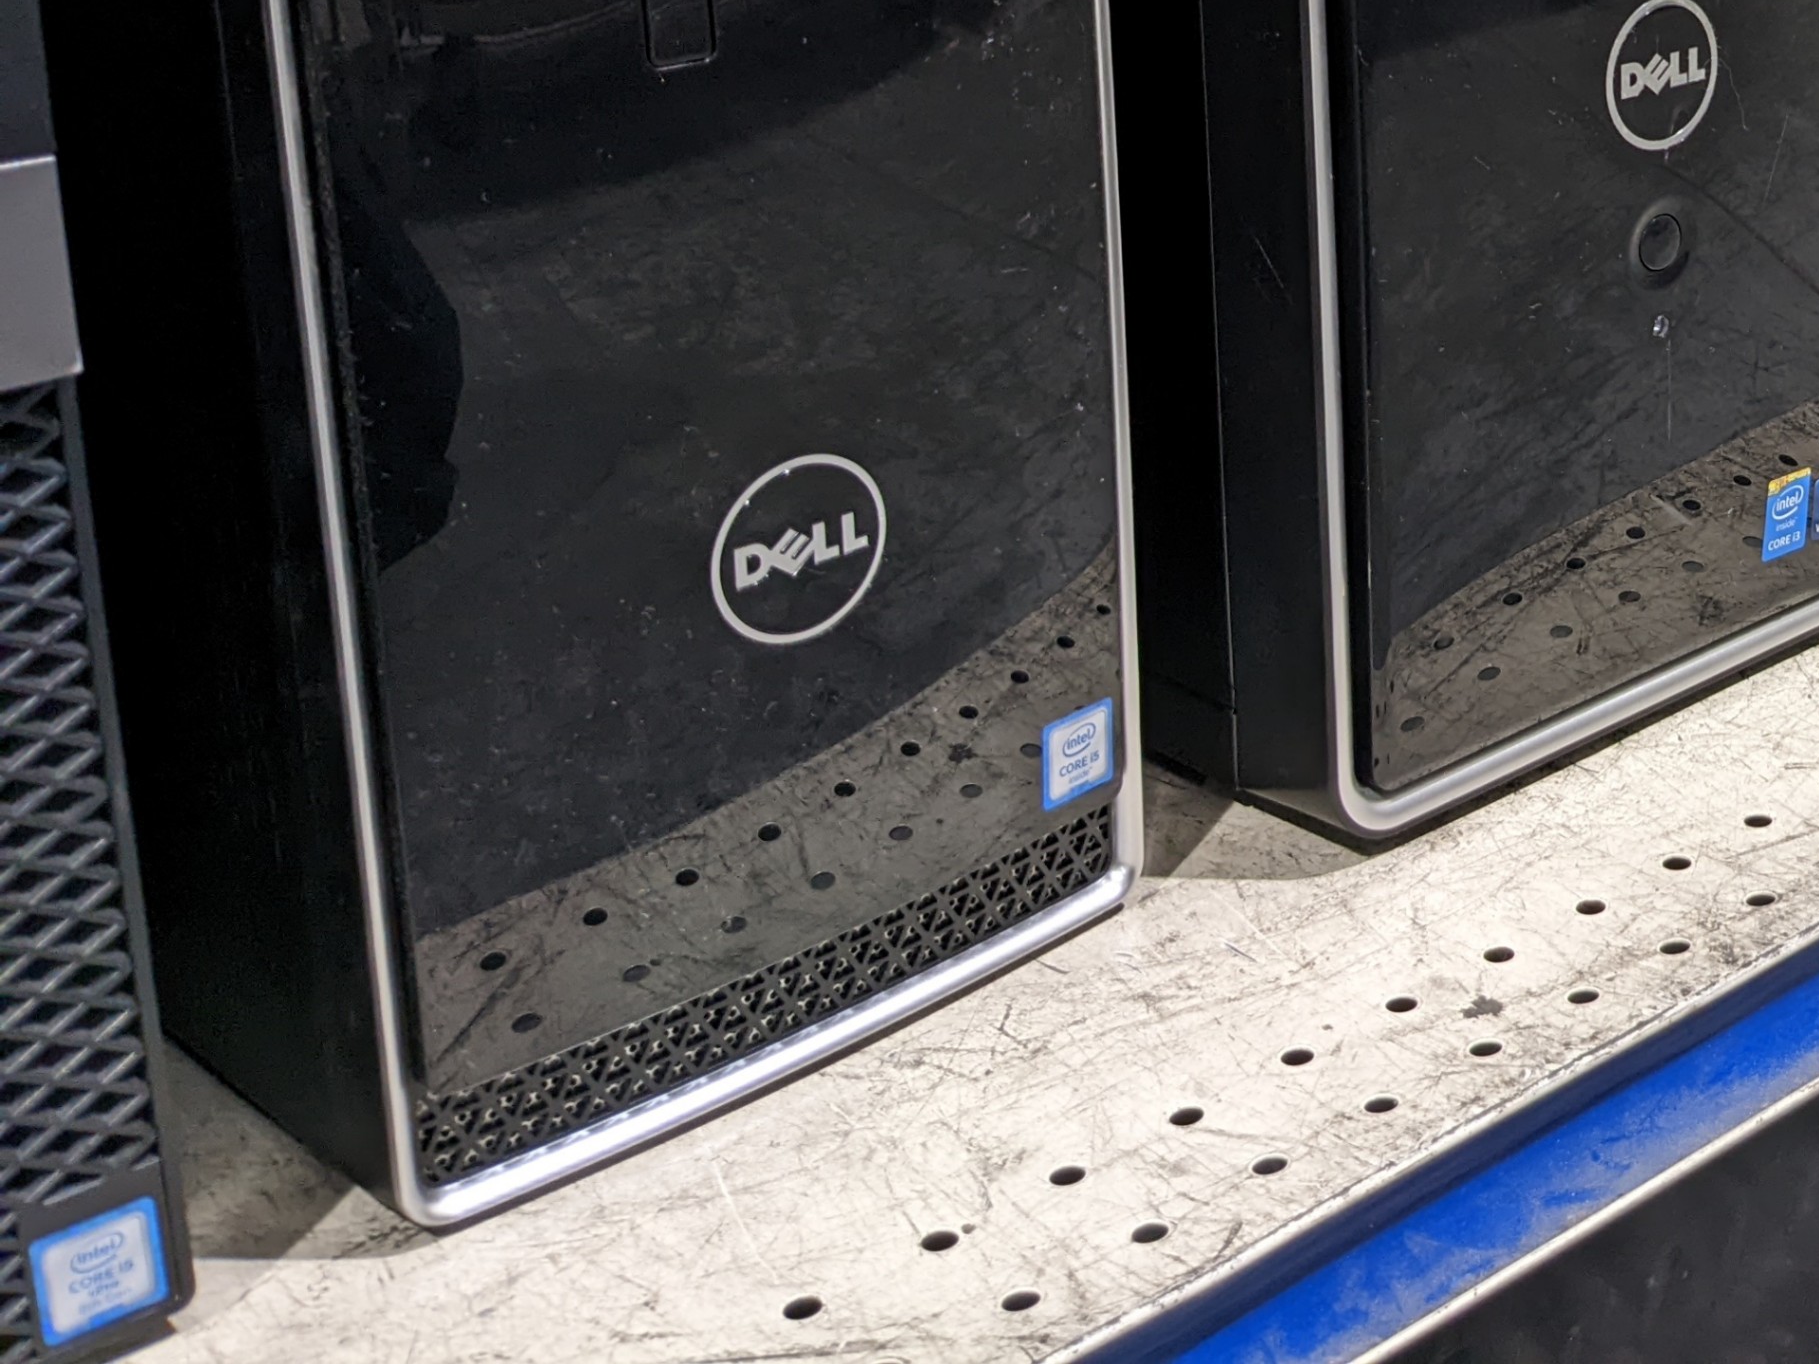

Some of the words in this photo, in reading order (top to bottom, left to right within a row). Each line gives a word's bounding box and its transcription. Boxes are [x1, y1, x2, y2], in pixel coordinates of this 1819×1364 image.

[1620, 46, 1707, 101] DELL
[1776, 490, 1801, 512] intel
[733, 511, 870, 592] DELL
[1768, 534, 1791, 552] CORE
[1792, 530, 1801, 542] i3
[1066, 728, 1094, 750] intel
[1059, 755, 1088, 778] CORE
[1090, 749, 1100, 763] i5
[77, 1237, 116, 1263] intel
[68, 1267, 114, 1294] CORE
